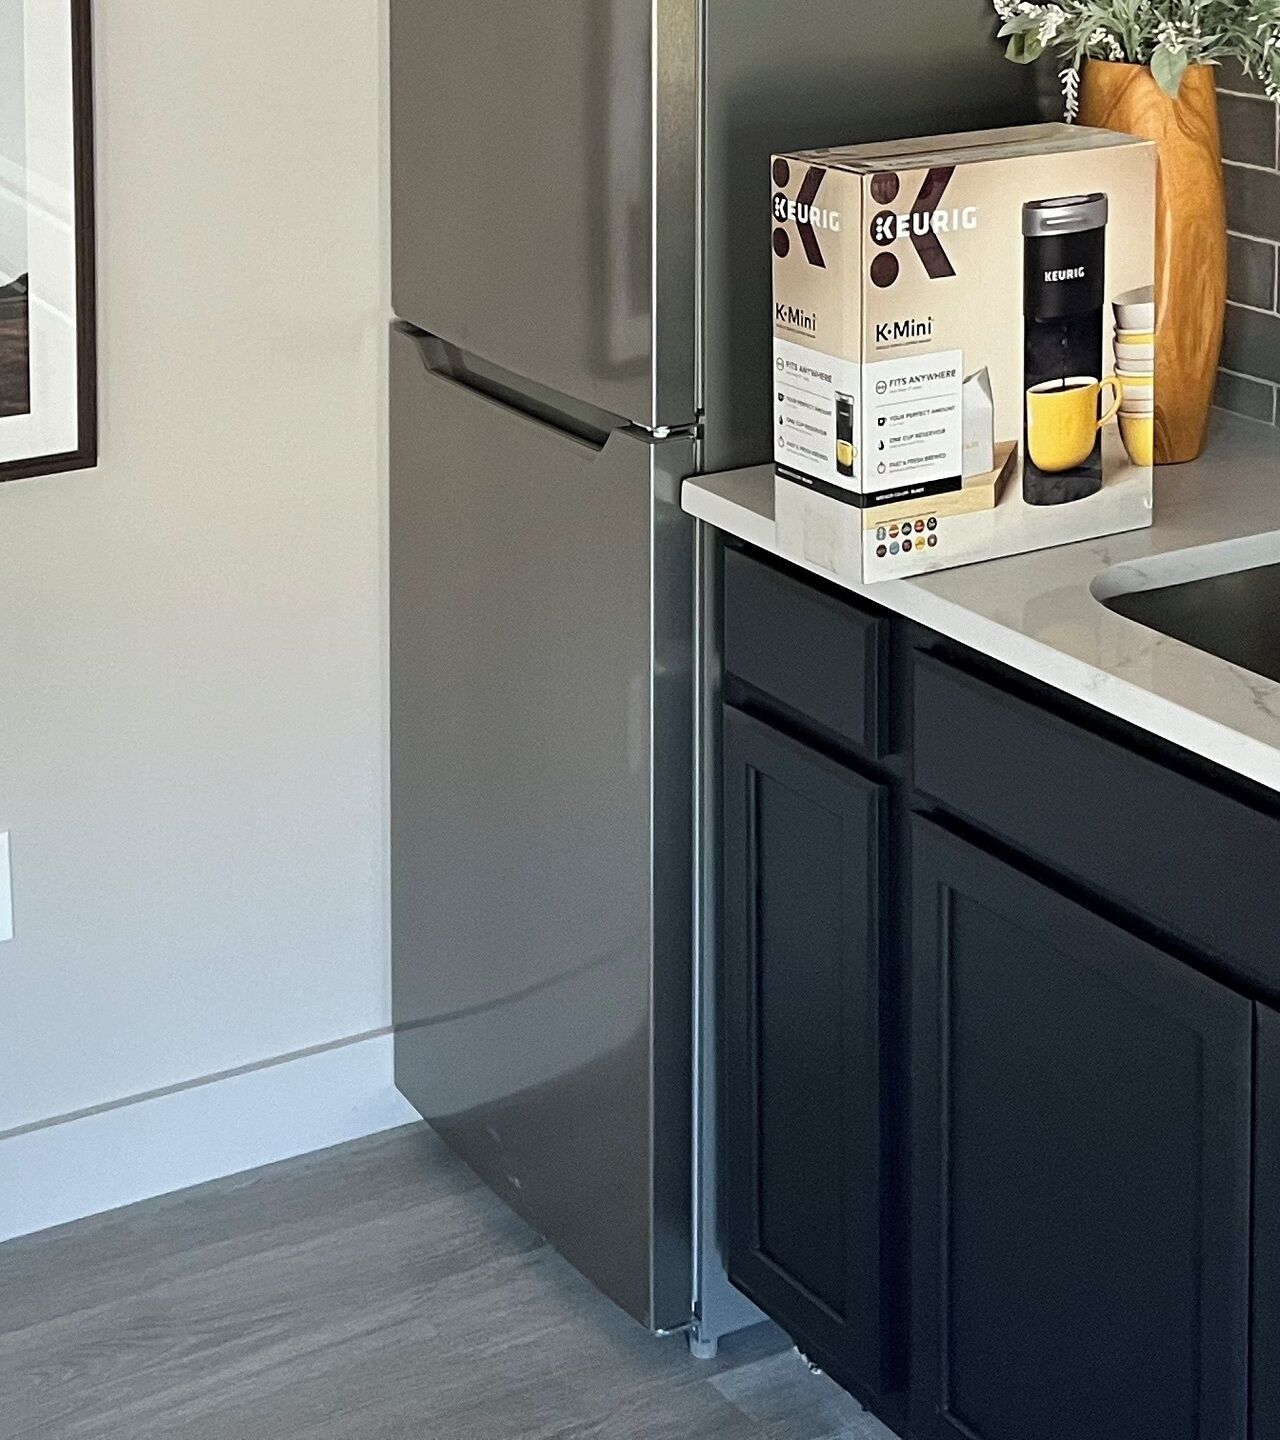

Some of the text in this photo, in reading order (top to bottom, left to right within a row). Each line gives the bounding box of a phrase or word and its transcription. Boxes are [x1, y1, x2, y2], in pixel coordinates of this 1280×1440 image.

[775, 196, 841, 232] KEURIG
[875, 206, 977, 241] KEURIG
[1044, 266, 1085, 282] KEURIG
[889, 369, 956, 388] FITS ANYWHERE
